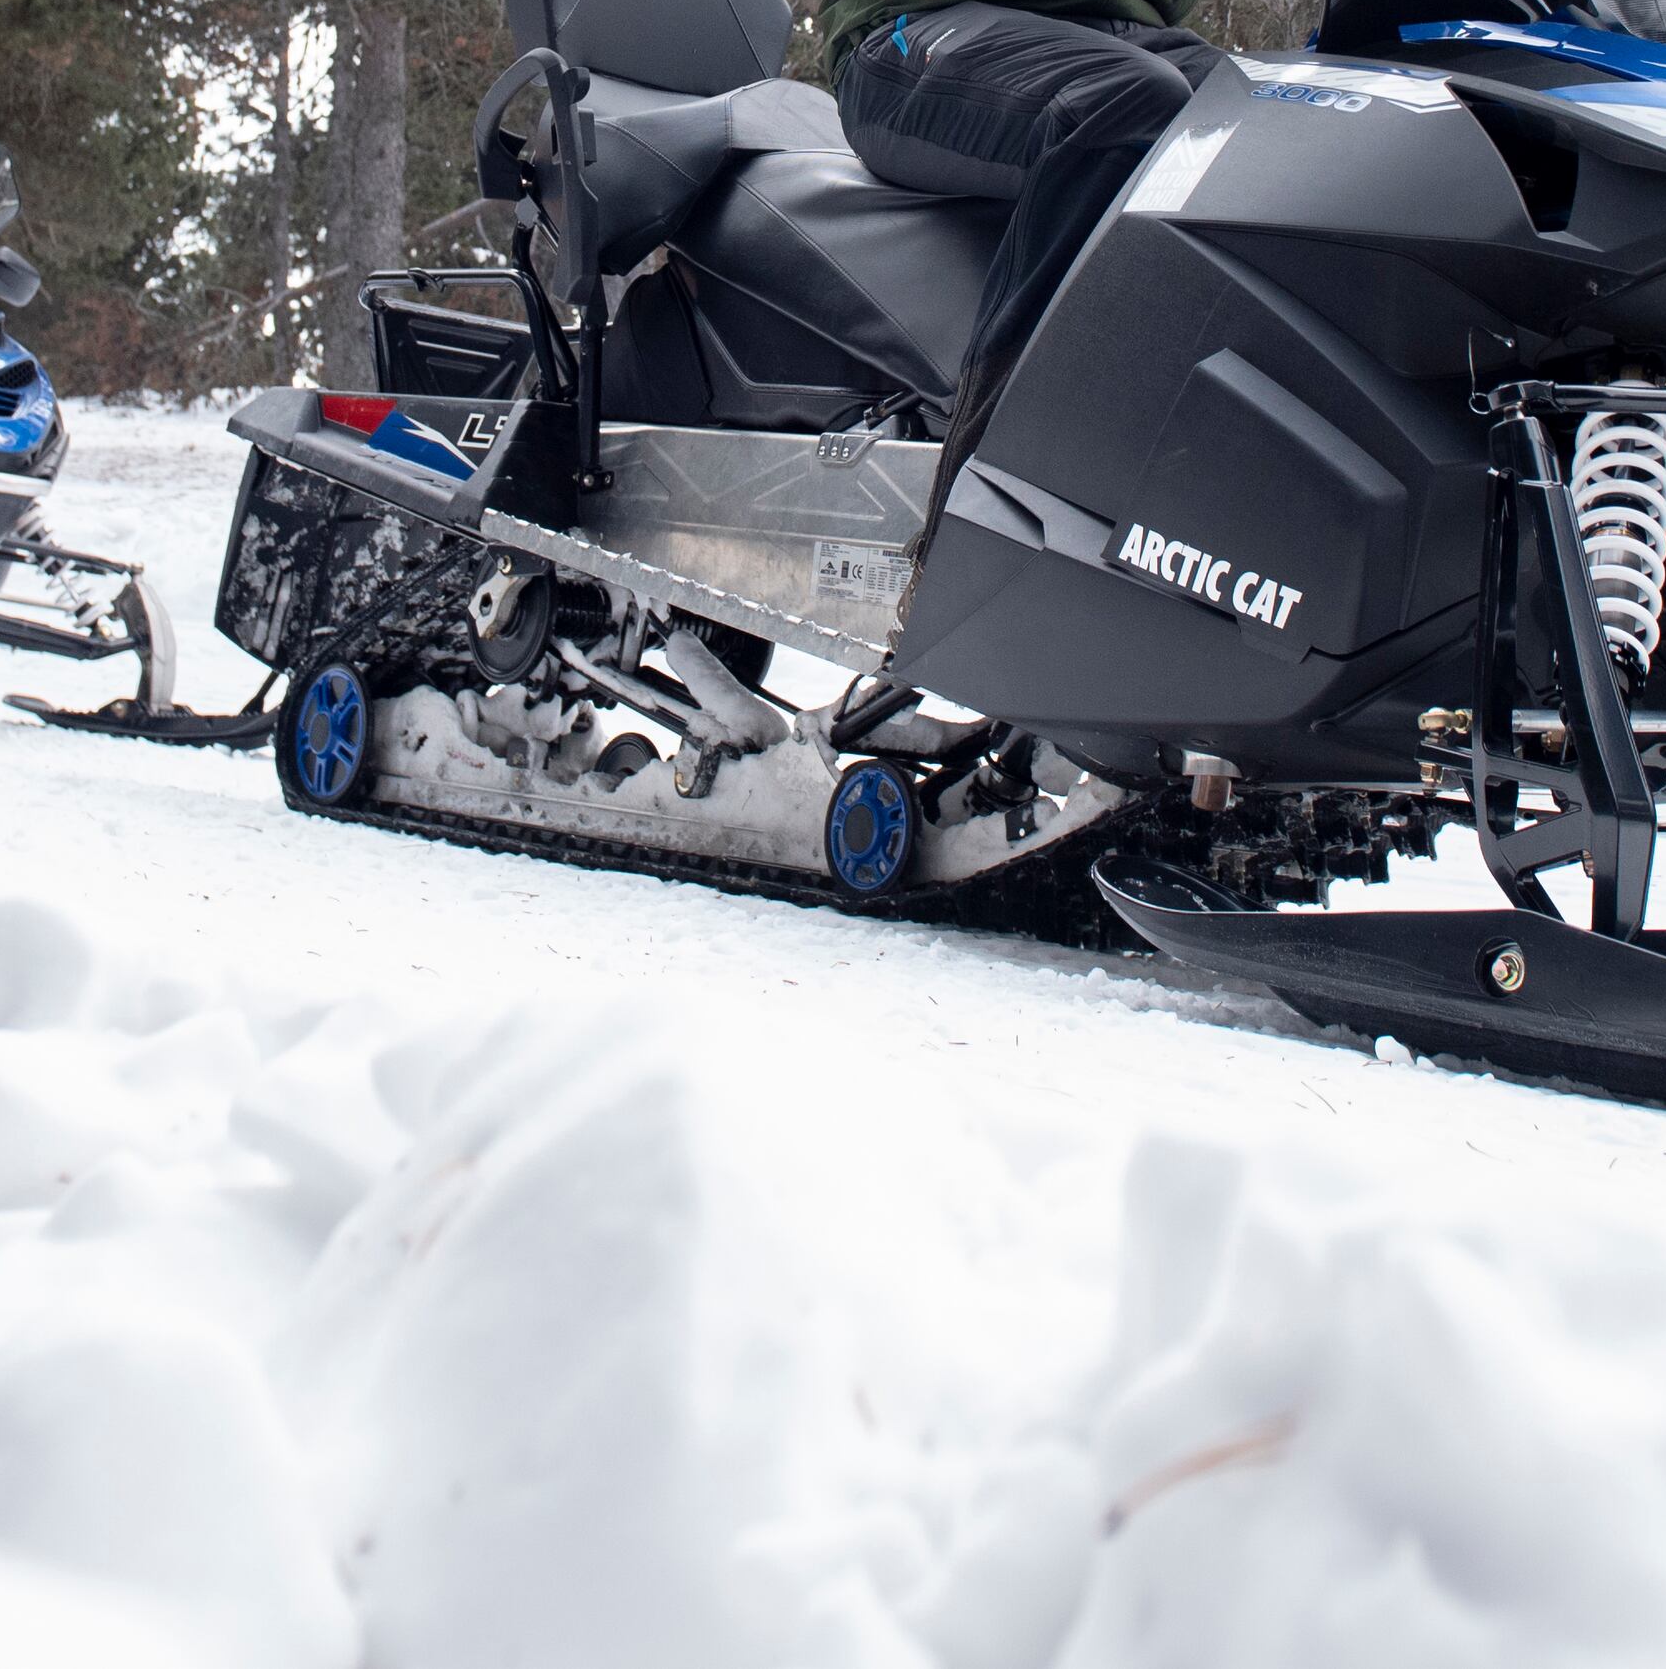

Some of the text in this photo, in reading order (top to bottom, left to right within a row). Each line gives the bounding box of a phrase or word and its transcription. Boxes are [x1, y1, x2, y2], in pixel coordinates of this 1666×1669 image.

[1250, 81, 1372, 113] 3000
[1118, 522, 1303, 630] ARCTIC CAT
